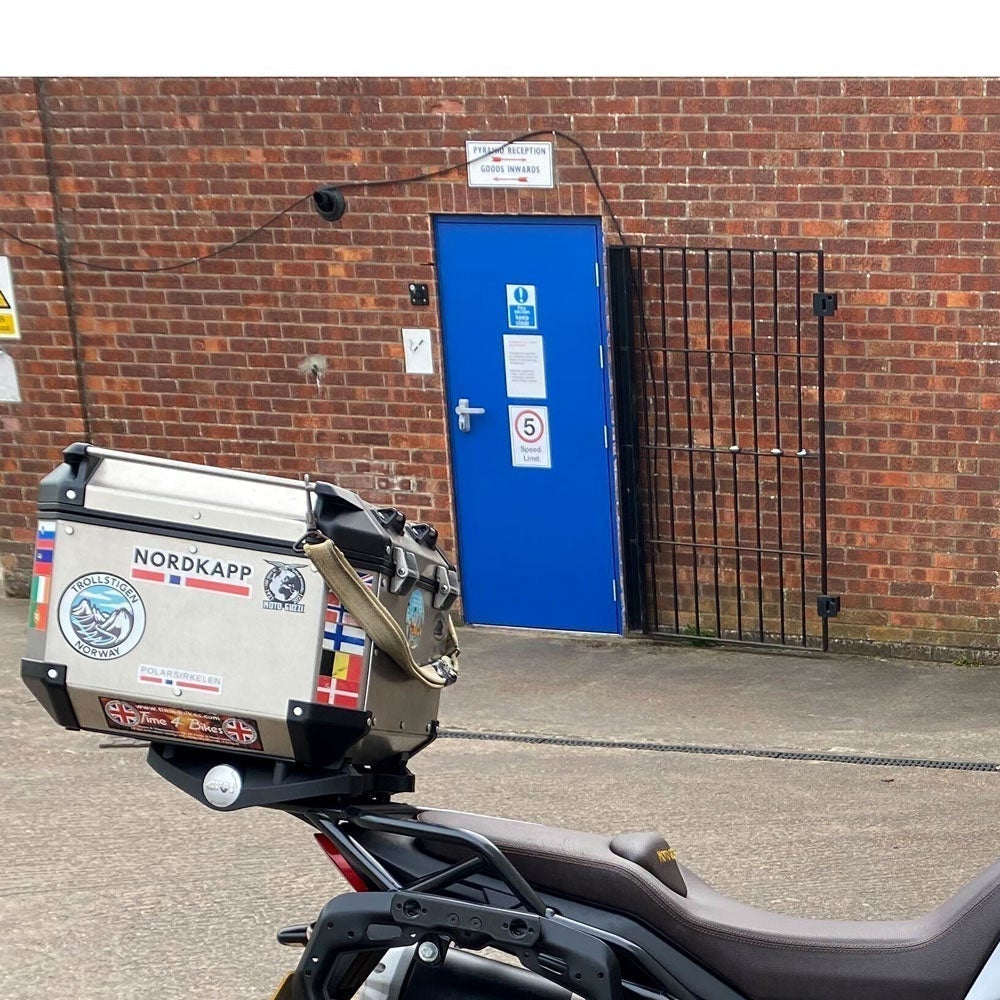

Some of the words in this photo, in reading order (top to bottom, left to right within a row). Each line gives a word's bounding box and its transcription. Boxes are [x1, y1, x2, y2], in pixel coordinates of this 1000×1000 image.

[473, 146, 505, 155] PYRAMID
[507, 147, 546, 155] RECEPTION
[480, 165, 504, 173] GOODS
[507, 165, 540, 174] INWARDS
[523, 417, 536, 436] 5
[520, 445, 541, 453] Speed
[133, 547, 252, 581] NORDKAPP
[70, 575, 139, 604] TROLLSTIGEN
[263, 601, 282, 610] MOTO
[284, 603, 304, 613] GUZZI
[74, 640, 120, 658] NORWAY
[140, 665, 221, 685] POLARSIRKELEN
[139, 710, 167, 727] Time
[170, 716, 184, 728] 4
[187, 718, 224, 735] Bikes
